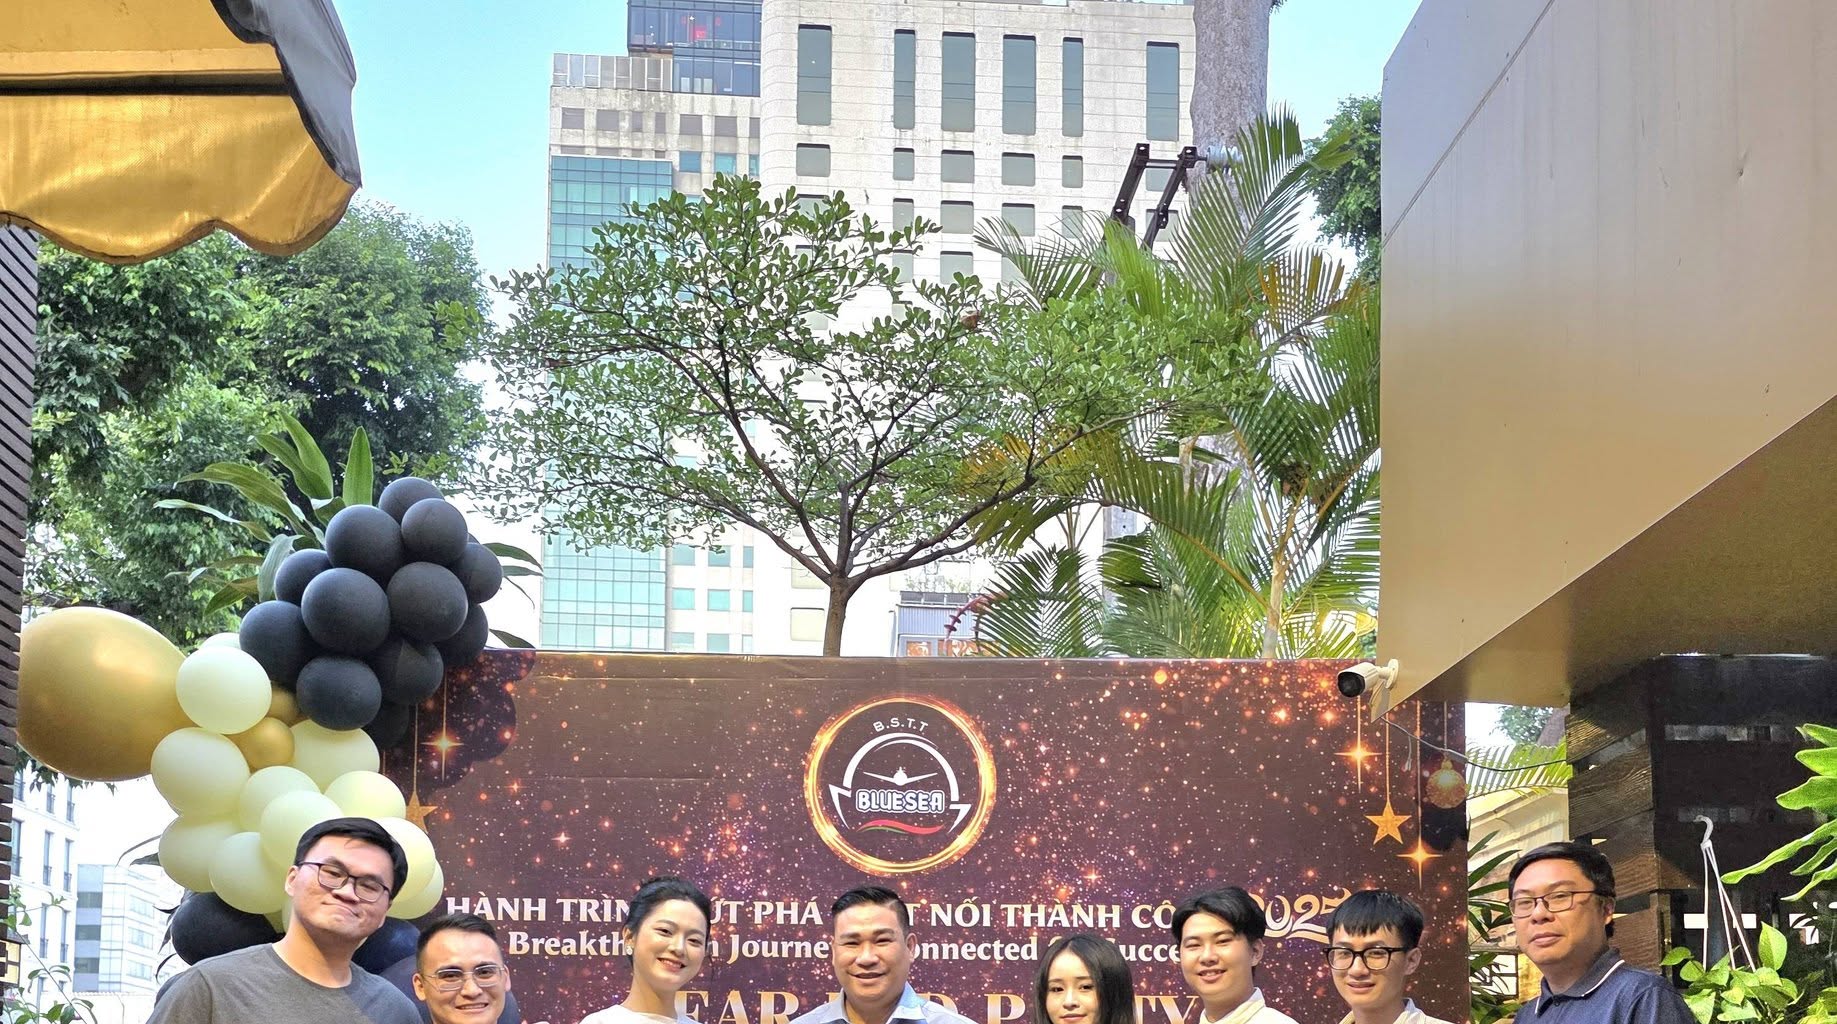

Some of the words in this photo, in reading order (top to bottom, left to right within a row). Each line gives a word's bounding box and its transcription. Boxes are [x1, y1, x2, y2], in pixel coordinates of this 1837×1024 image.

[873, 717, 929, 732] B.S.T.T
[856, 789, 945, 814] BLUESEA
[446, 891, 546, 921] HÀNH
[556, 893, 631, 922] TRÌN
[753, 896, 823, 925] PHÁ
[930, 896, 991, 927] NỐI
[1001, 898, 1121, 928] THÀNH
[1131, 900, 1176, 929] CÔ
[509, 931, 627, 956] Breakth
[726, 934, 832, 964] Journe
[914, 936, 1038, 961] nnected
